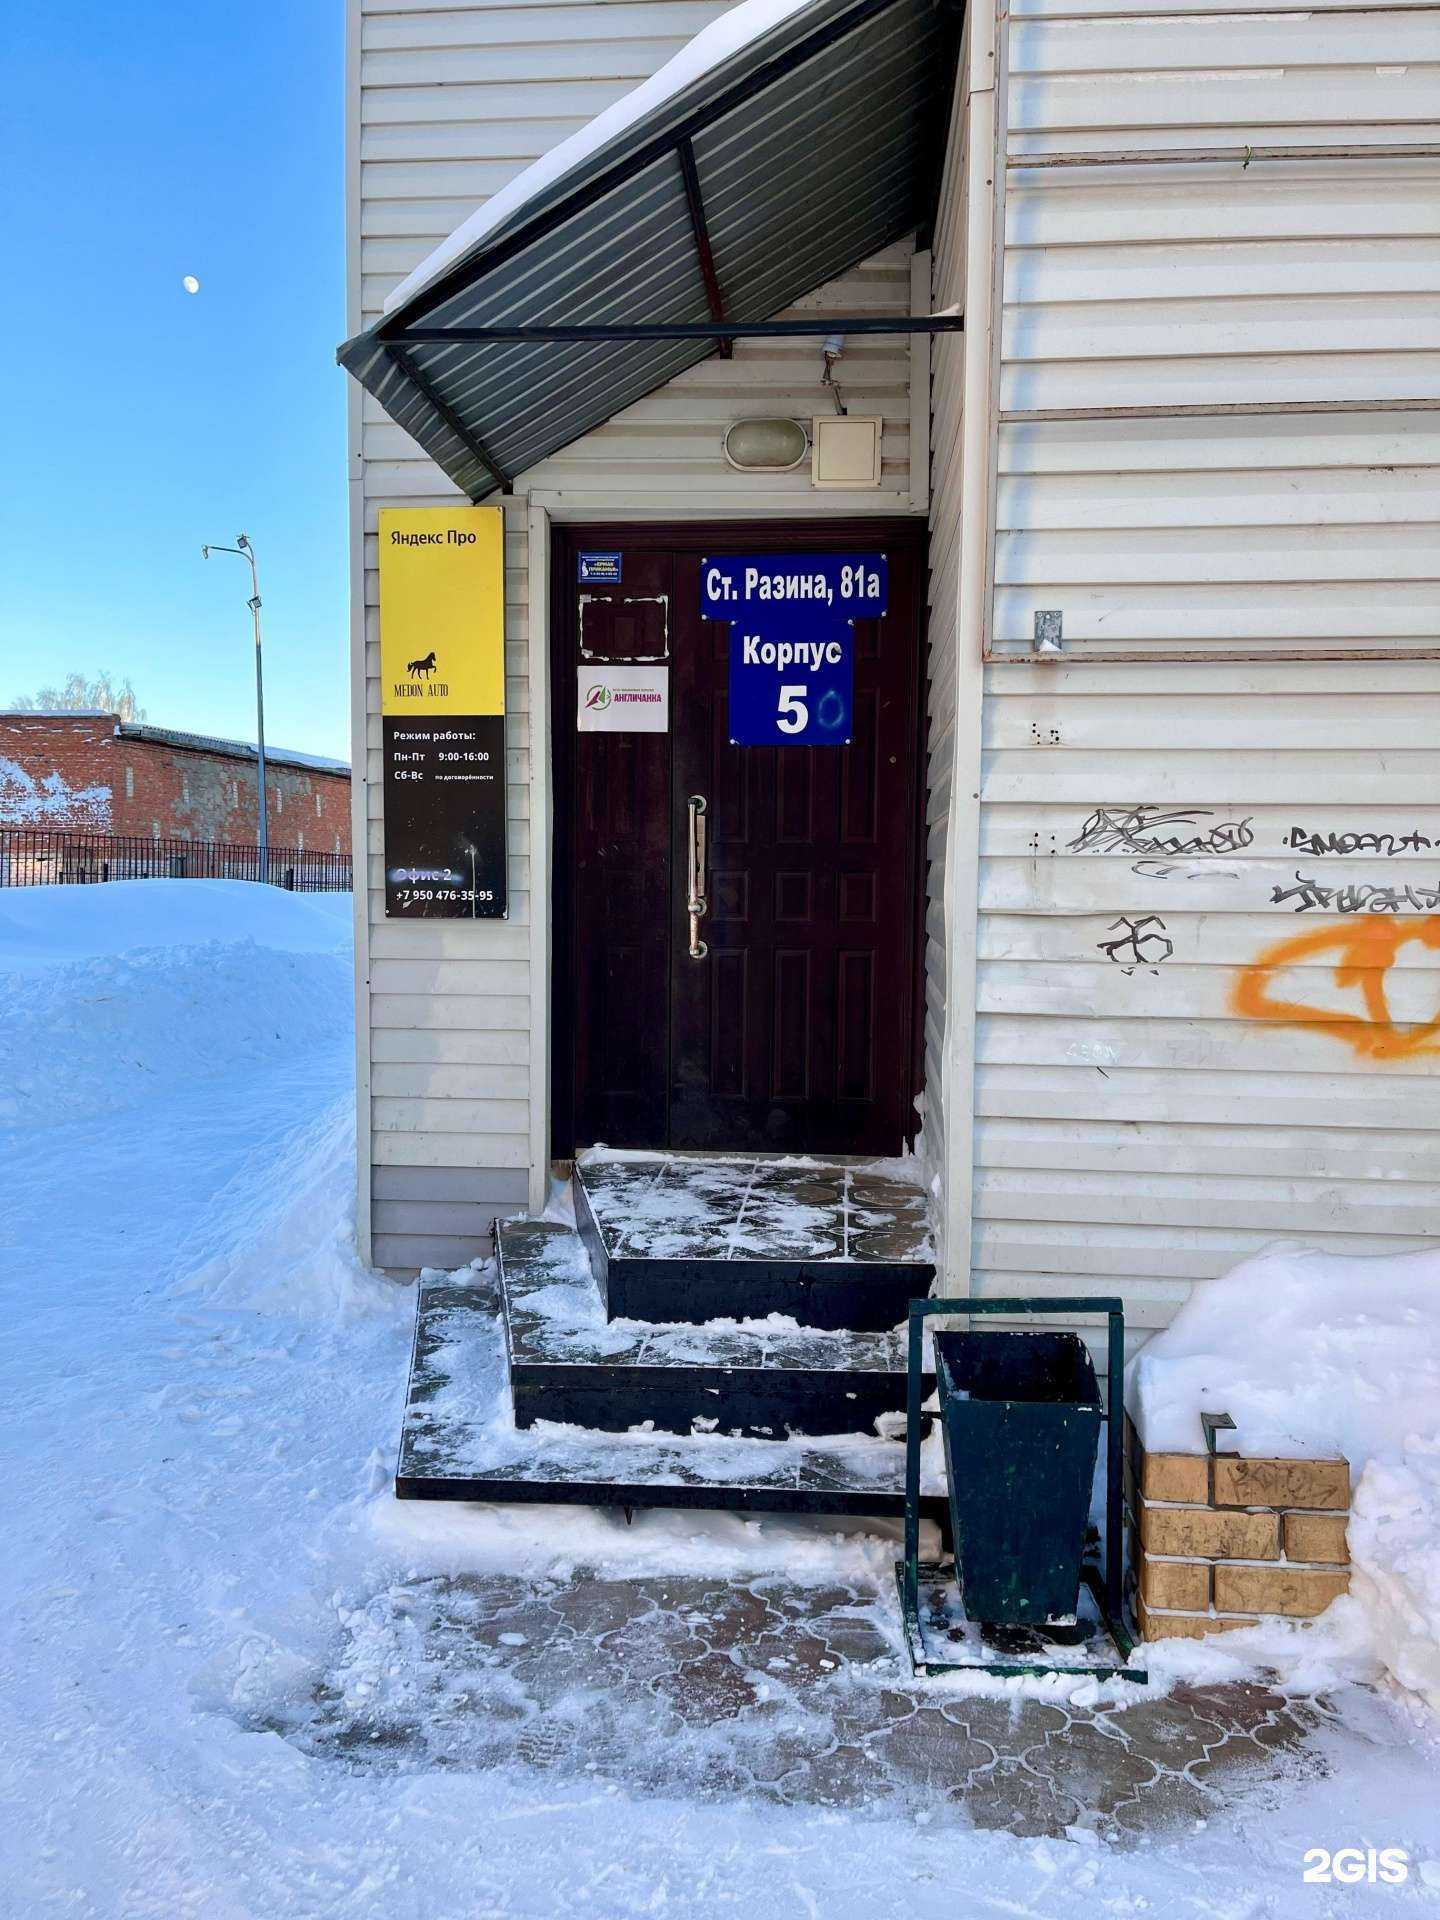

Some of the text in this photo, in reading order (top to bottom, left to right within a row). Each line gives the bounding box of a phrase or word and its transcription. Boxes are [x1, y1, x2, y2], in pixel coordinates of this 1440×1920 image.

[391, 530, 477, 547] Яндекс Про
[706, 565, 880, 607] Ст. Разина, 81а
[743, 635, 842, 672] Корпус
[394, 684, 449, 697] MEDON AUTO
[393, 731, 477, 742] Режим работы:
[393, 752, 490, 761] Пн-Пт 9:00-16:00
[394, 771, 424, 780] Сб-Вс
[443, 868, 452, 881] 2
[396, 890, 493, 901] +7 950 476-35-95
